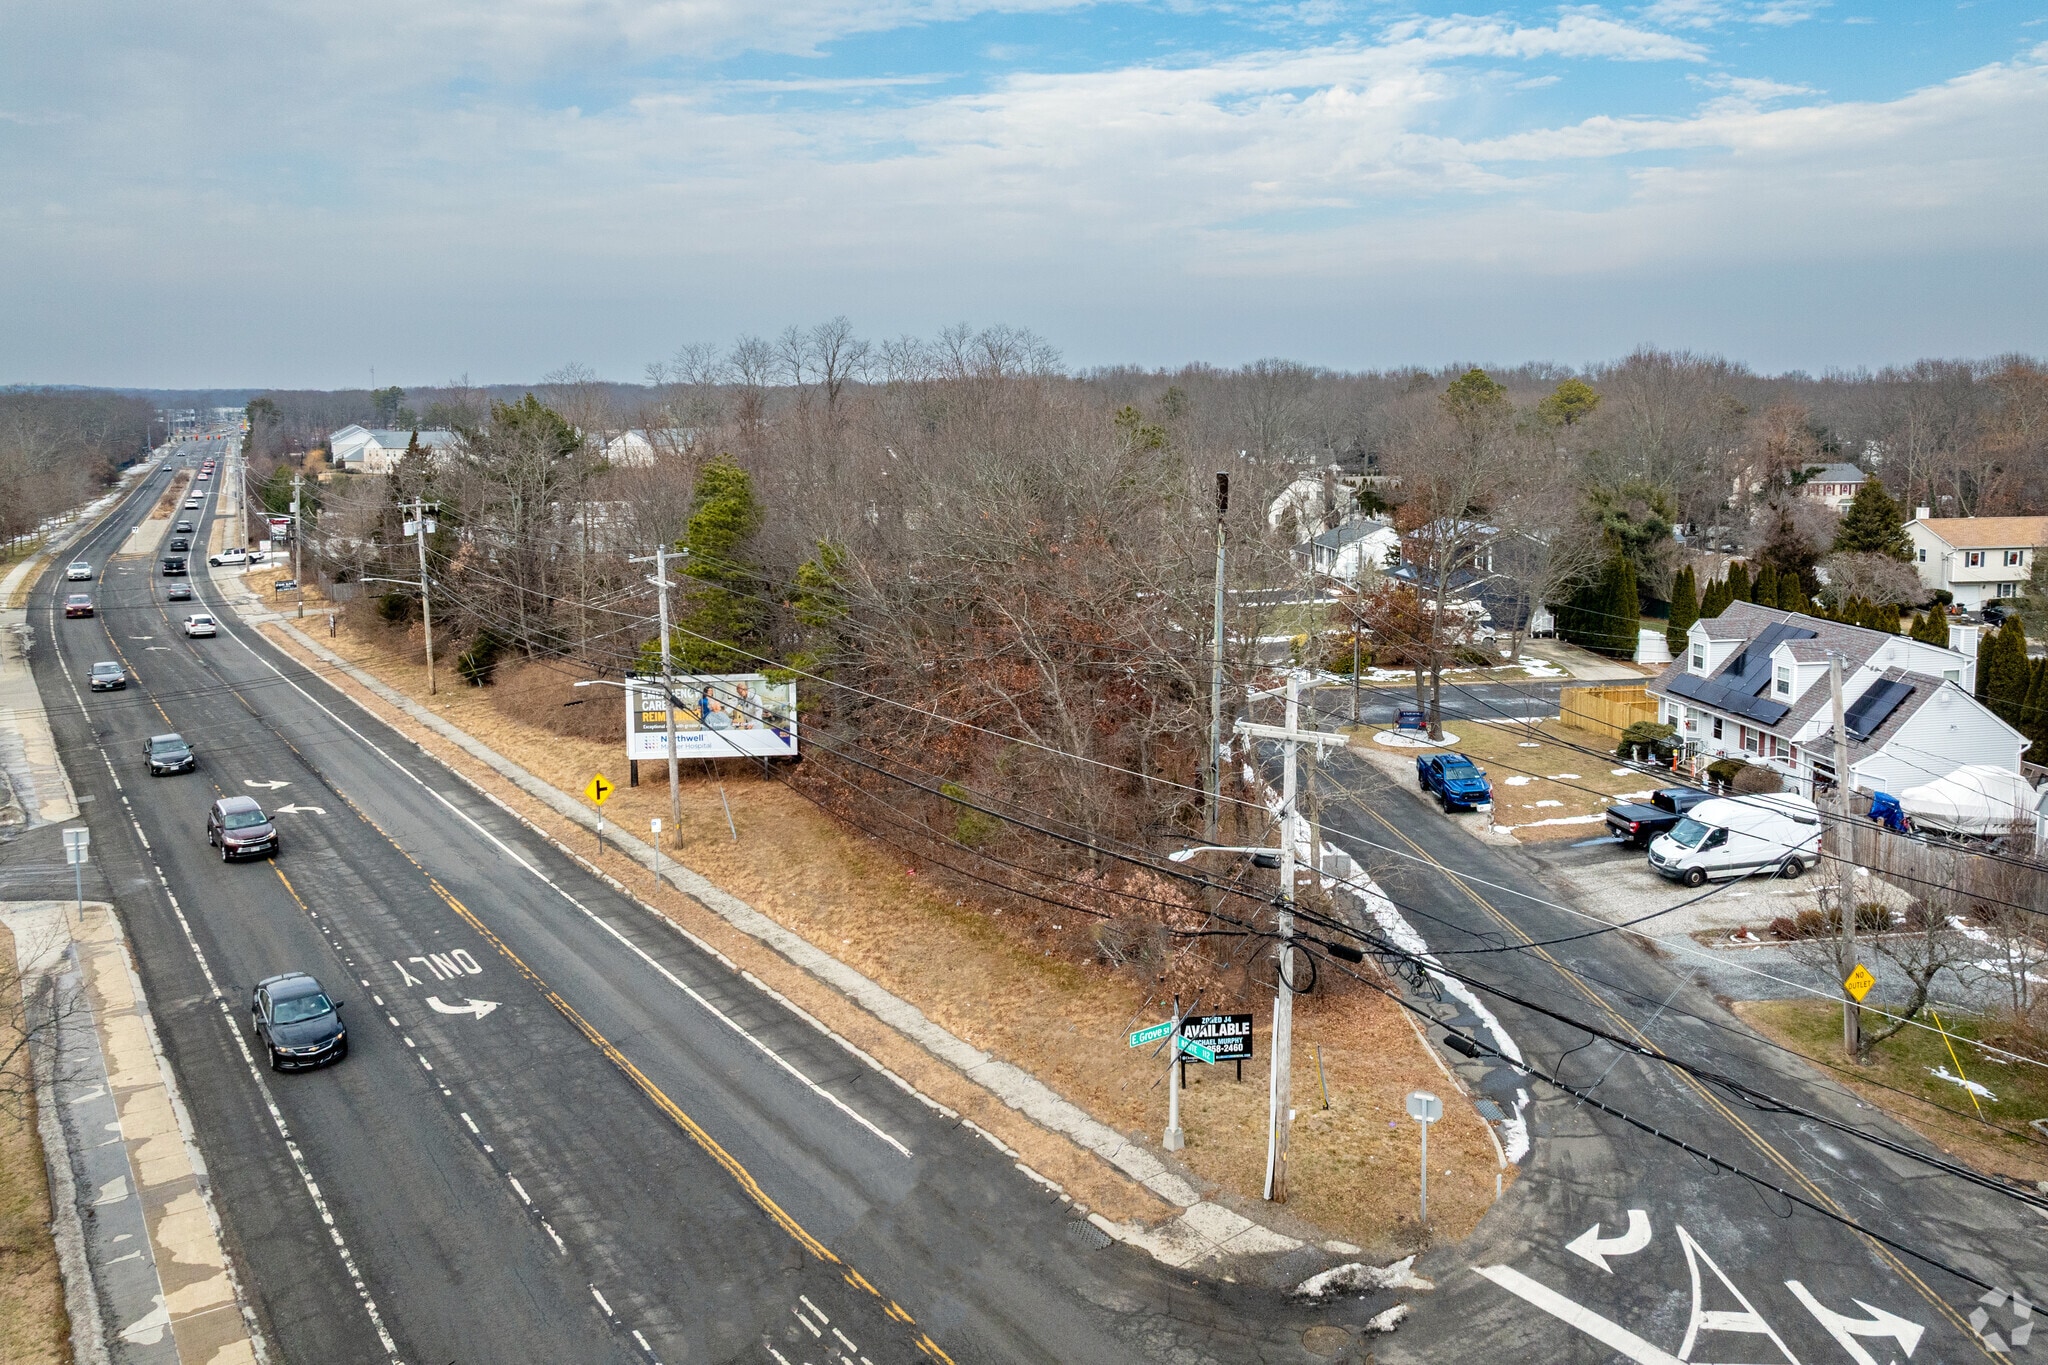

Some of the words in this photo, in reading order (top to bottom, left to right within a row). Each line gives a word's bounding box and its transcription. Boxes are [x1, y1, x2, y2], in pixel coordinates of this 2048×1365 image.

[642, 687, 700, 700] EMEENCY
[642, 700, 666, 711] CARE
[660, 734, 704, 742] Nrthwell
[686, 743, 712, 751] Hospital
[392, 948, 483, 987] ONLY
[1848, 980, 1871, 990] OUTLET
[1202, 1016, 1222, 1024] ZONED
[1132, 1035, 1139, 1044] E.
[1139, 1028, 1162, 1042] Grove
[1184, 1022, 1250, 1038] AVAILABLE
[1181, 1039, 1198, 1054] ROUTE
[1202, 1050, 1211, 1060] 112
